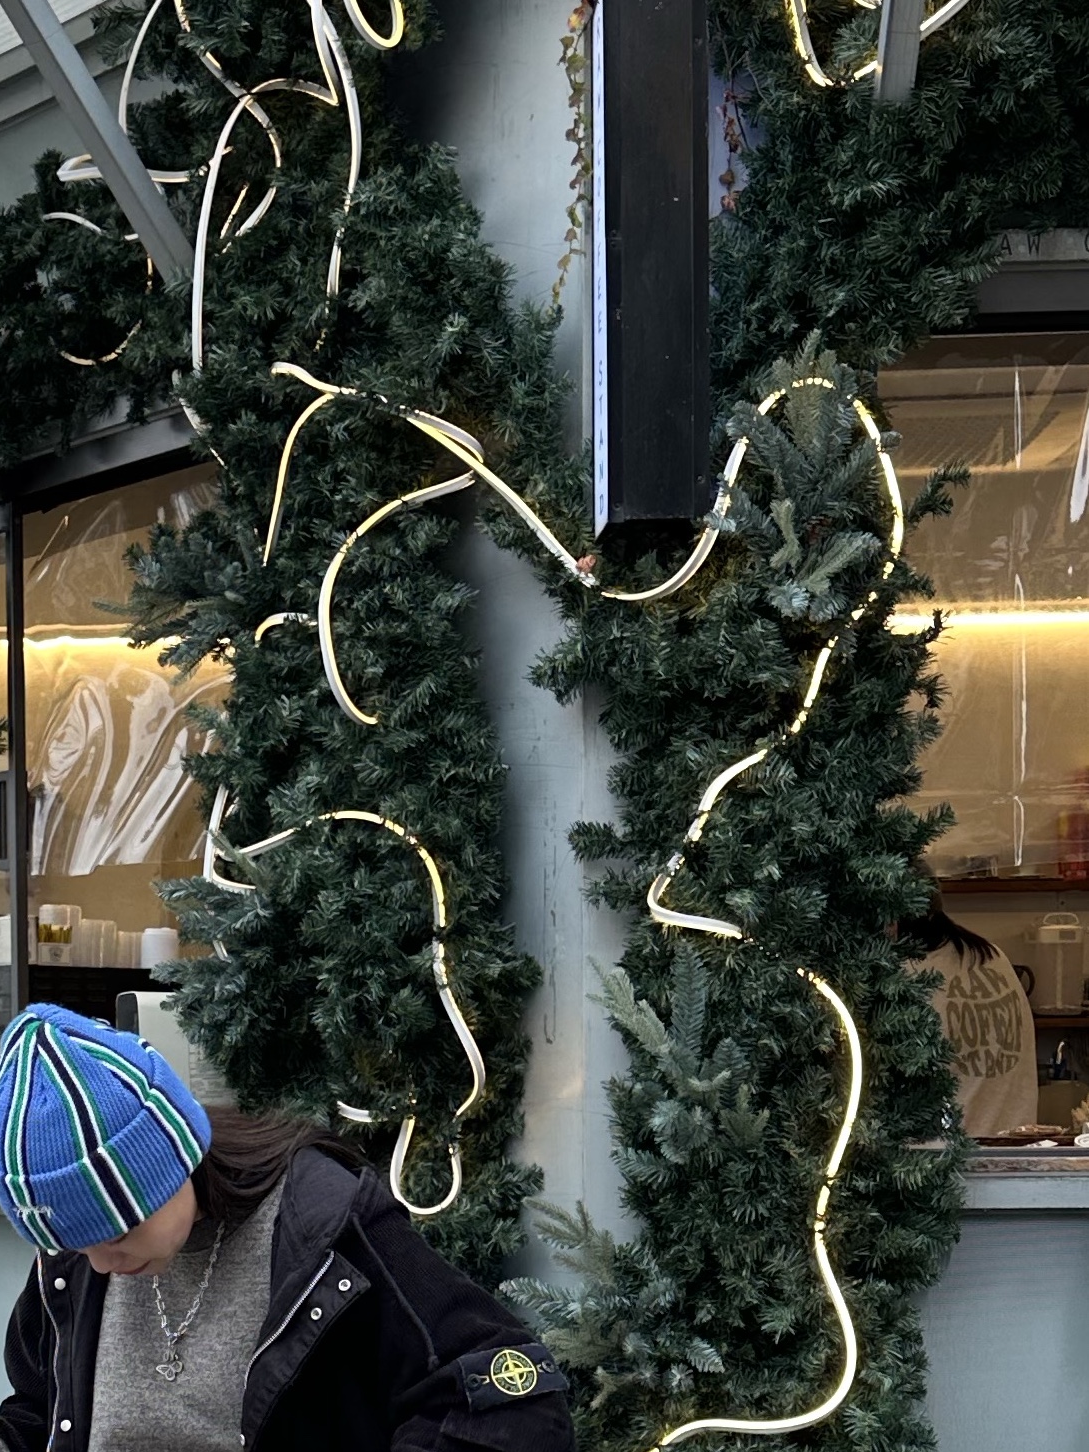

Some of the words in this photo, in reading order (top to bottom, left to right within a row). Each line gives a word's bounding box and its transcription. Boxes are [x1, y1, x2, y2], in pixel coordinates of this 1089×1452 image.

[1001, 233, 1041, 255] AW
[946, 965, 1010, 1000] RAW
[946, 990, 1023, 1054] COFFEE
